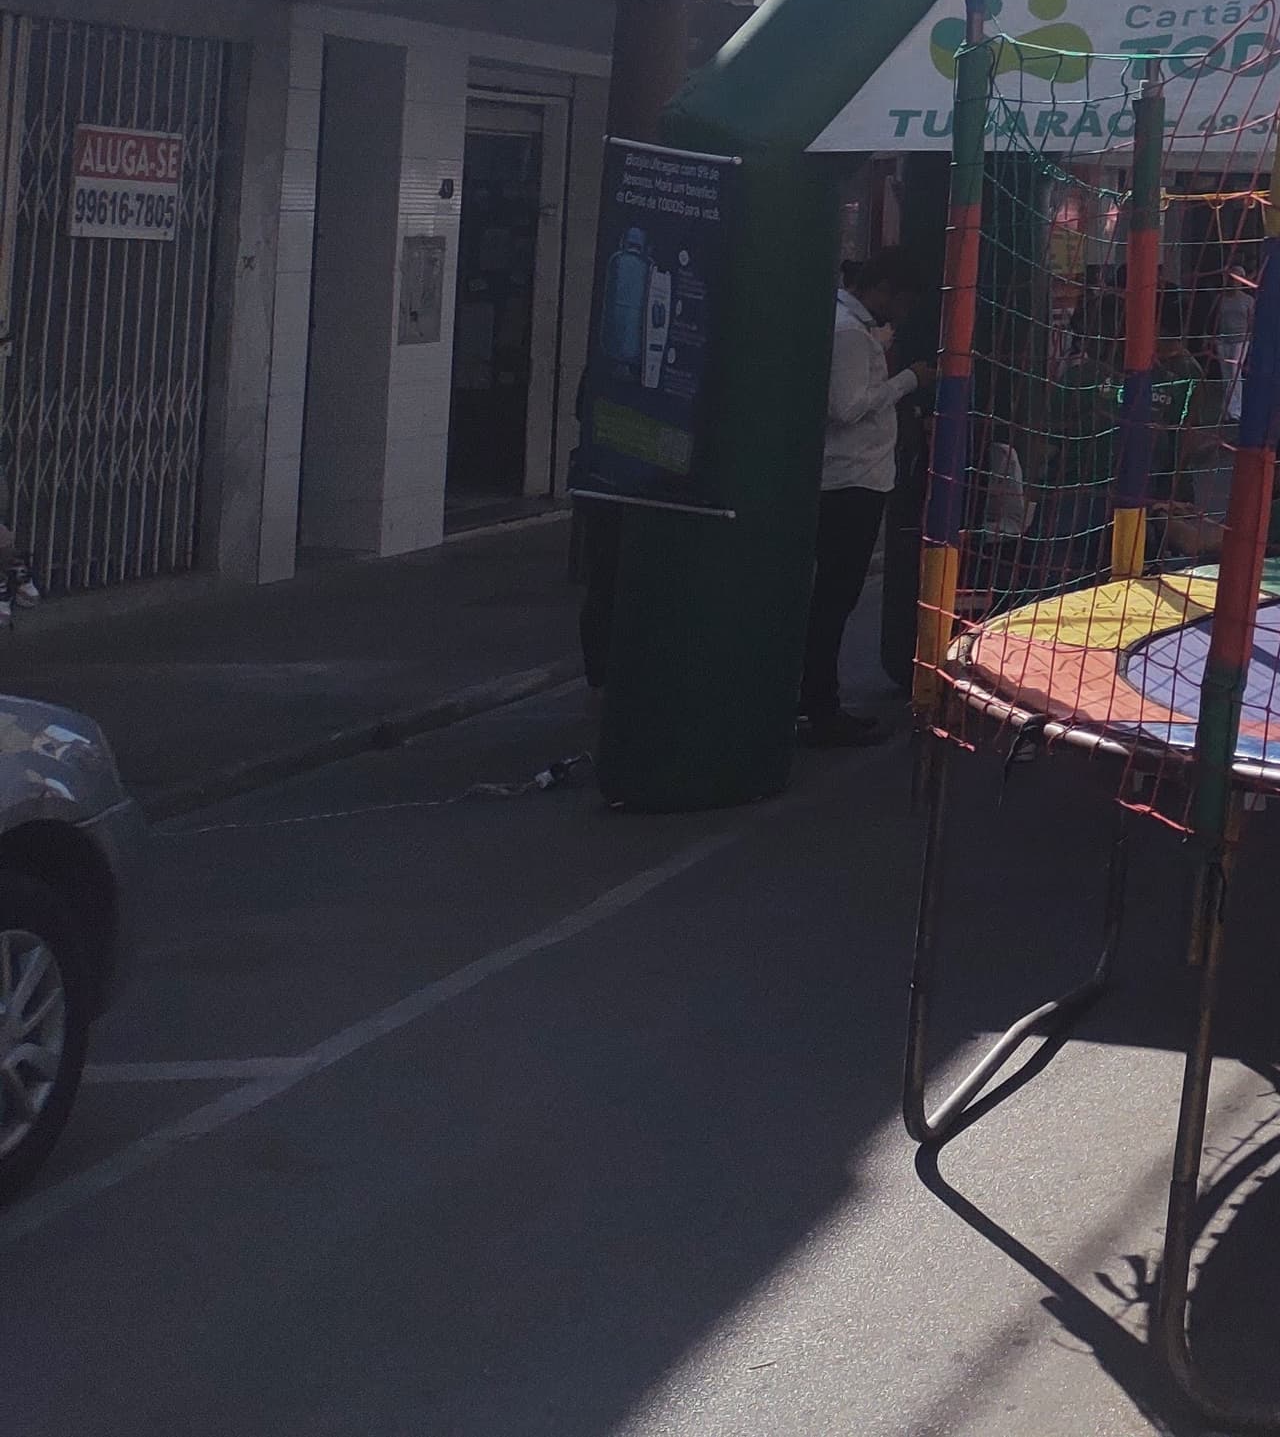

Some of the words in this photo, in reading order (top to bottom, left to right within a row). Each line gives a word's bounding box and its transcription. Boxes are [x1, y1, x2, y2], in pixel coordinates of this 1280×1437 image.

[1125, 0, 1268, 29] Cartão
[888, 102, 1136, 138] TUARÃO
[79, 133, 179, 179] ALUGA-SE
[75, 188, 177, 228] 99616-7805
